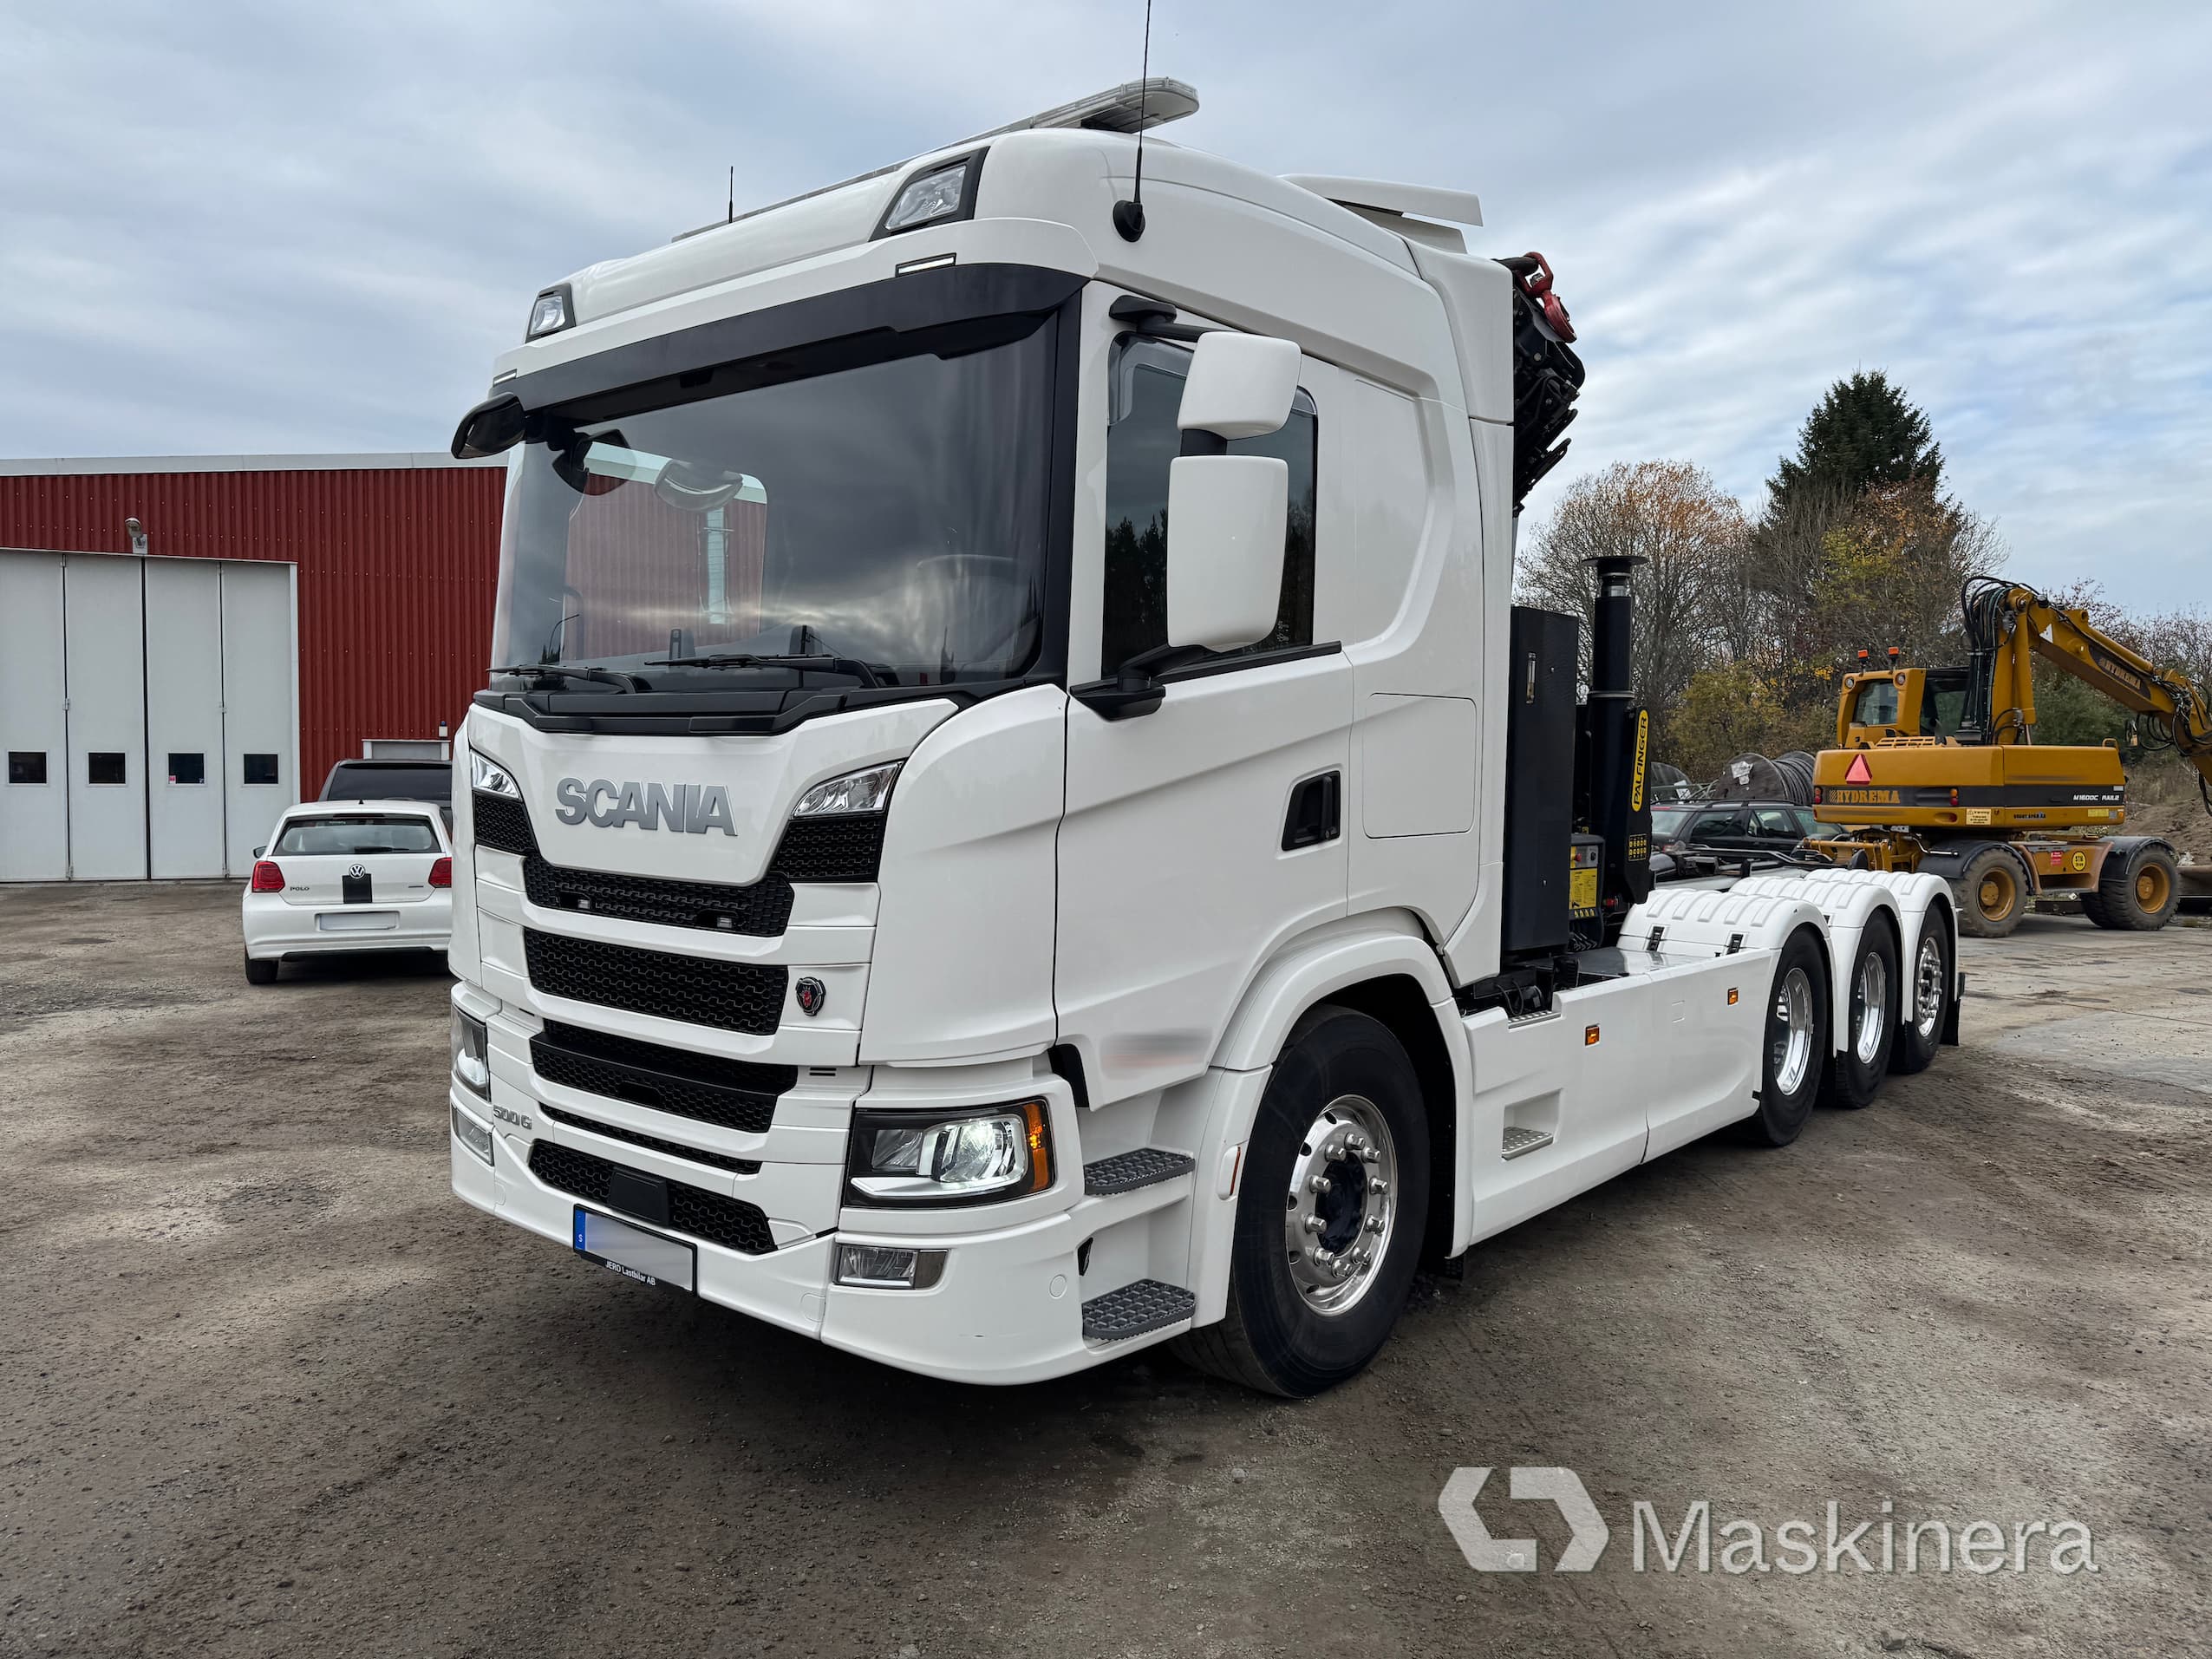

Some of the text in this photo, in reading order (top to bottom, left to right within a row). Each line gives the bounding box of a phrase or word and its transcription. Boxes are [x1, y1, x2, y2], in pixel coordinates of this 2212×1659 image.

[2104, 659, 2141, 690] HYDREMA
[1634, 716, 1647, 805] PALFINGER
[555, 777, 738, 836] SCANIA
[1836, 790, 1901, 804] HYDREMA
[349, 864, 365, 878] VW
[493, 1105, 519, 1127] 500
[578, 1234, 583, 1243] S
[605, 1260, 656, 1286] JERO Lastbilar AB
